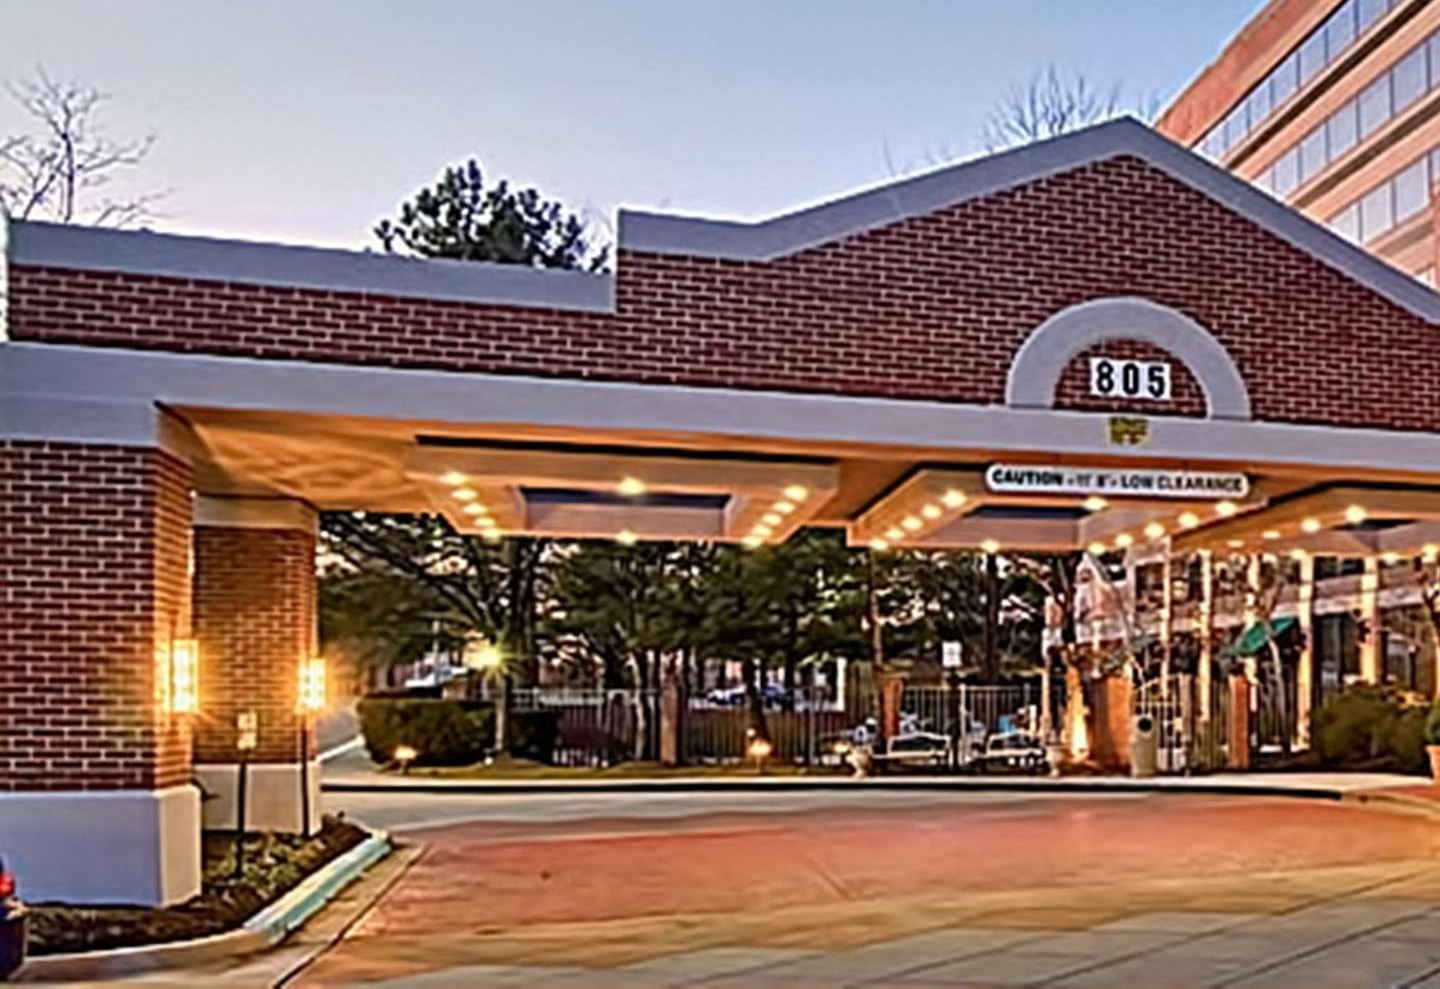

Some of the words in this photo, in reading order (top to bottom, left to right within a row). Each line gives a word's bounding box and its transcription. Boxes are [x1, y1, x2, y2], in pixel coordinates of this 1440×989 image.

[1096, 360, 1166, 397] 805
[992, 468, 1063, 486] CAUTION
[1121, 474, 1152, 490] LOW
[1157, 474, 1242, 492] CLEARANCE
